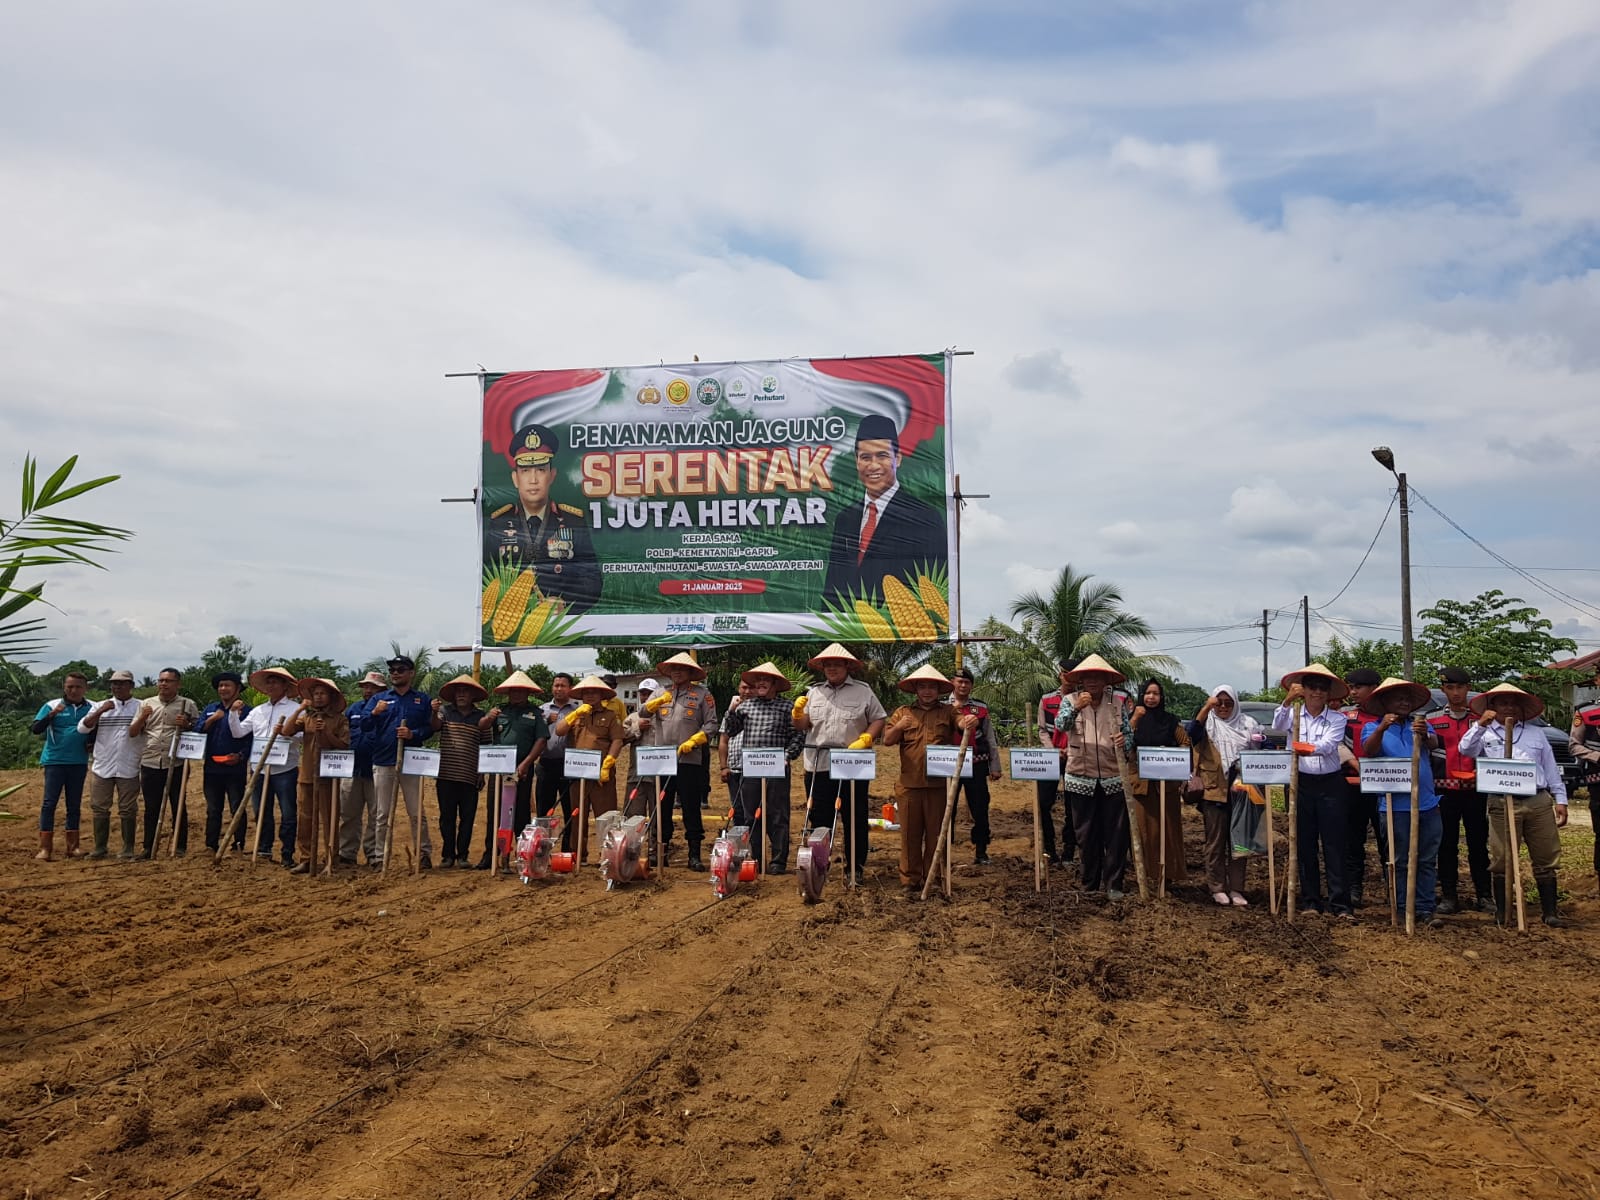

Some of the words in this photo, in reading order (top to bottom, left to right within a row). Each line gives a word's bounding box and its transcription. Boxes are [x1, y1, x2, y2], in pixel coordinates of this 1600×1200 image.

[753, 394, 785, 402] Perhutani
[570, 421, 733, 448] PENANAMAN
[735, 416, 846, 445] JAGUNG
[582, 445, 834, 498] SERENTAK
[589, 501, 602, 529] 1
[607, 500, 693, 529] JUTA
[698, 497, 827, 527] HEKTAR
[682, 533, 712, 544] KERJA
[713, 533, 741, 543] SAMA
[646, 548, 674, 558] POLRI
[678, 547, 727, 558] KEMENTAN
[745, 547, 773, 556] GAPKI
[656, 562, 698, 572] INHUTANI
[703, 561, 740, 572] SWASTA
[745, 560, 791, 571] SWADAYA
[790, 560, 823, 570] PETANI
[682, 583, 691, 591] 21
[691, 583, 723, 591] JANUARI
[725, 583, 743, 591] 2025
[180, 744, 195, 752] PSR
[323, 754, 348, 762] MONEV
[831, 758, 854, 766] KETUA
[1141, 755, 1165, 763] KETUA
[1166, 756, 1186, 764] KTNA
[1245, 763, 1288, 771] APKASINDO
[1364, 767, 1408, 775] APKASINDO
[1486, 768, 1534, 777] APKASINDO
[1498, 779, 1522, 788] ACEH
